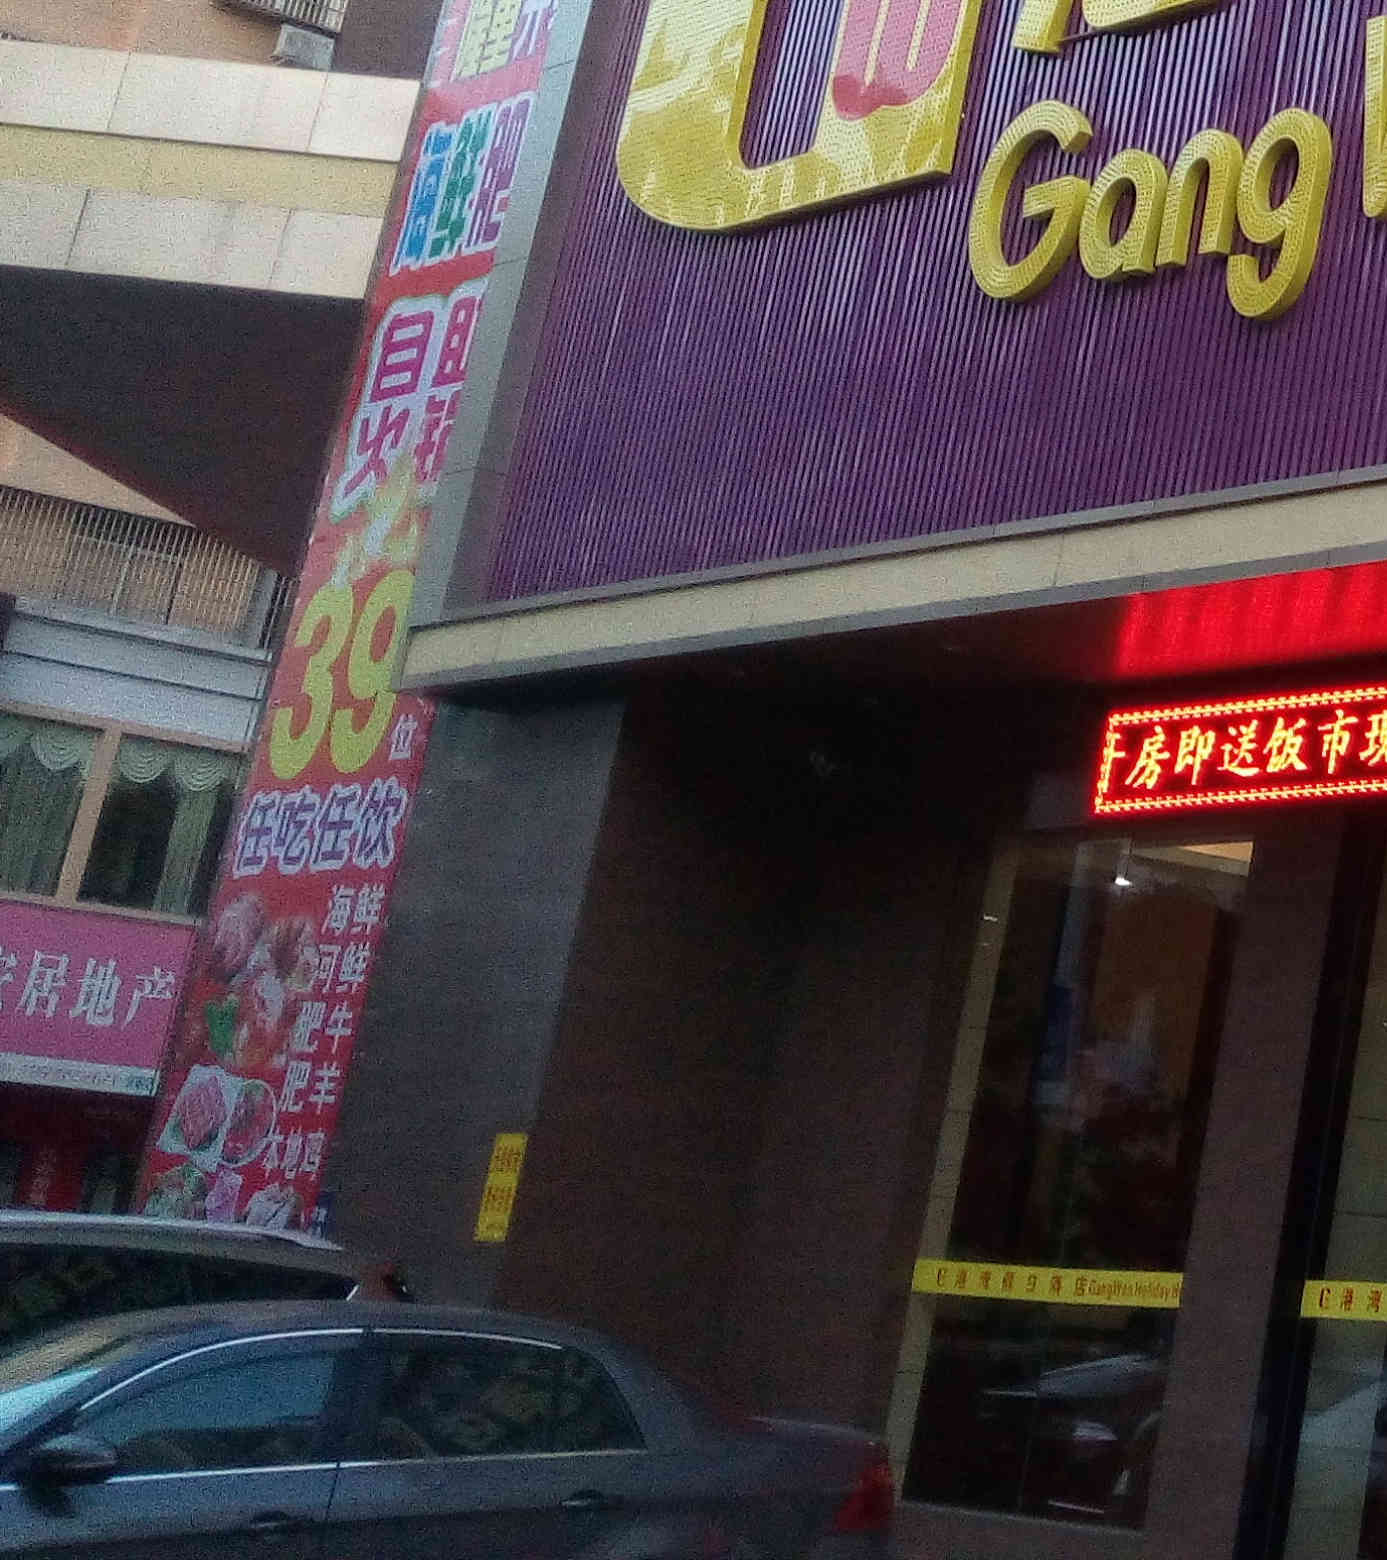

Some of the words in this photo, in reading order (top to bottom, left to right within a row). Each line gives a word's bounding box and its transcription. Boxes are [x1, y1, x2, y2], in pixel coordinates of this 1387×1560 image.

[967, 97, 1333, 321] Gang
[269, 568, 416, 781] 39
[322, 882, 386, 935] 海鲜
[291, 1000, 353, 1055] 肥牛
[279, 1058, 341, 1114] 肥羊
